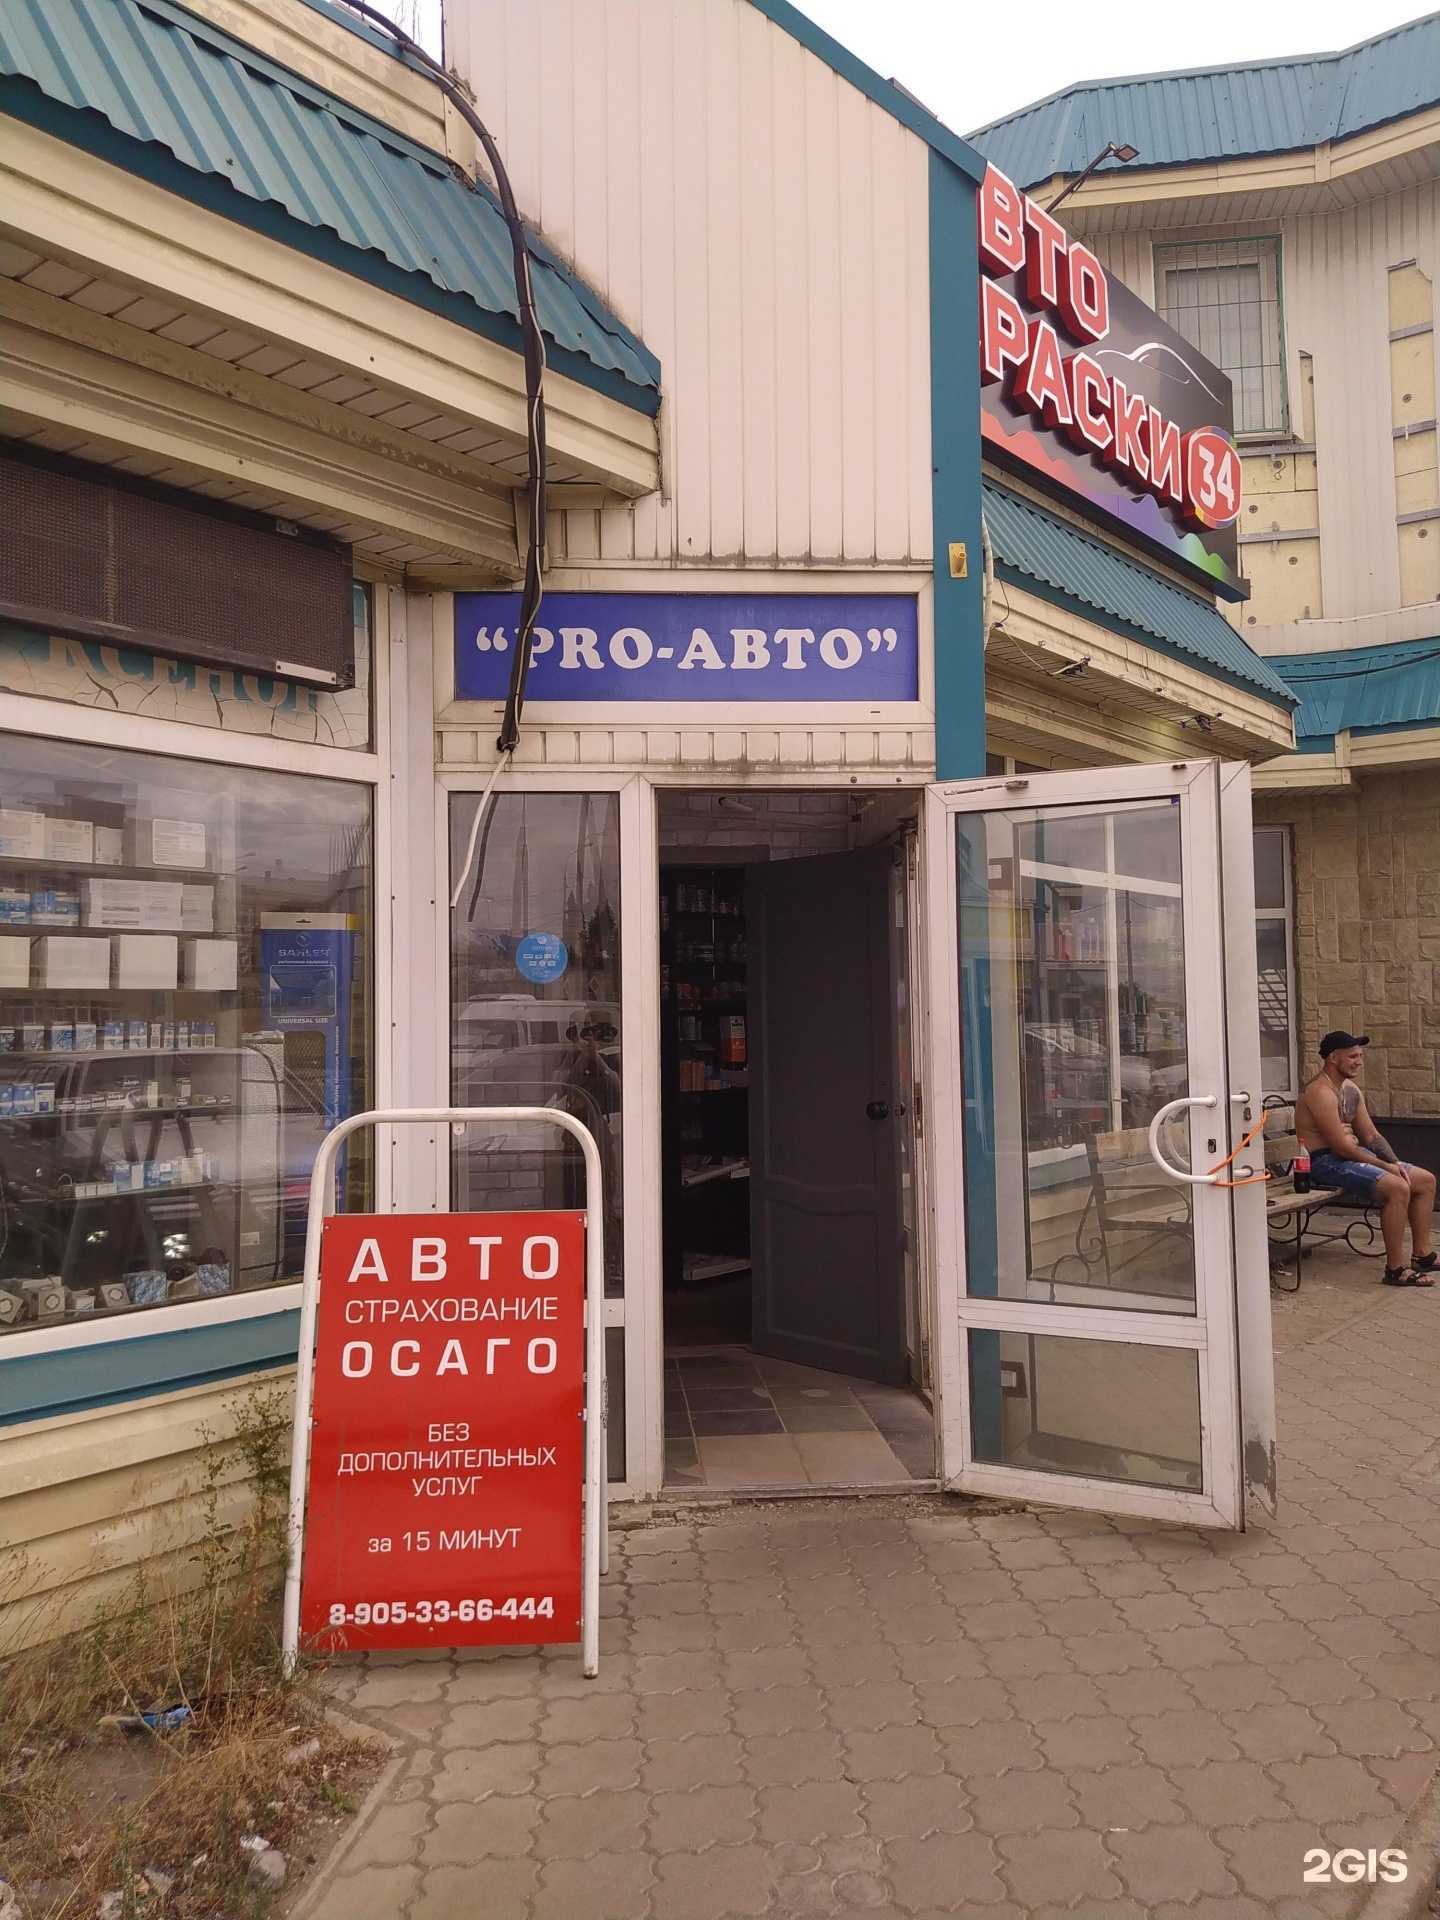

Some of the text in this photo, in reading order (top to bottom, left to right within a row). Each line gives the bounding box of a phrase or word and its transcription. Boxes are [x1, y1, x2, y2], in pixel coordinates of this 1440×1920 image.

[1198, 443, 1235, 511] 34
[347, 1235, 559, 1283] АВТО
[345, 1297, 559, 1324] СТРАХОВАНИЕ
[341, 1337, 558, 1378] ОСАГО
[428, 1423, 470, 1442] БЕЗ
[338, 1447, 557, 1476] ДОПОЛНИТЕЛЬНЫХ
[411, 1476, 483, 1496] УСЛУГ
[368, 1528, 521, 1553] за 15 МИНУТ
[329, 1596, 554, 1625] 8-905-33-66-444
